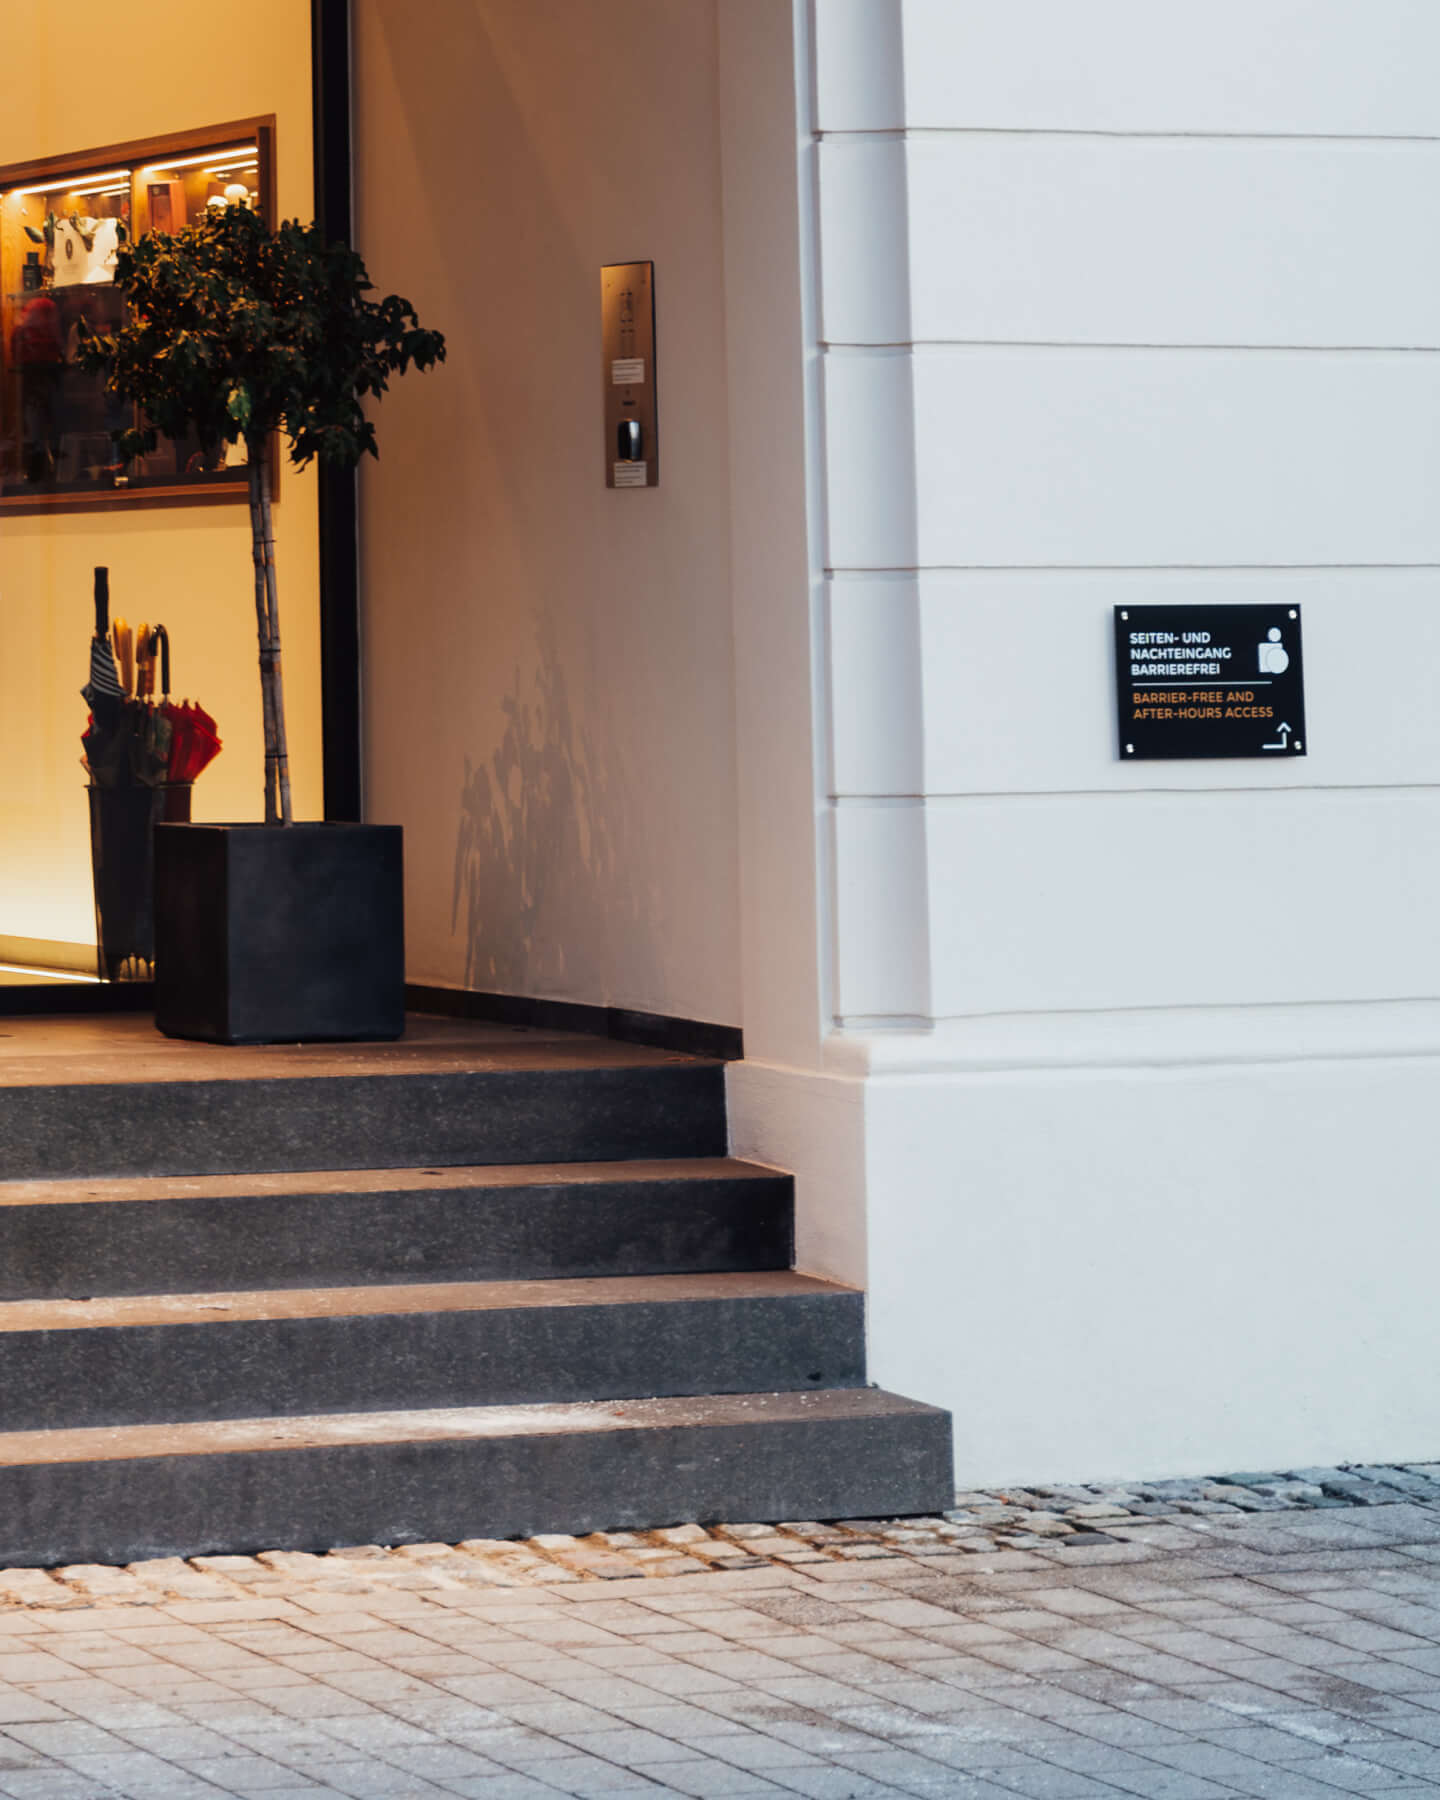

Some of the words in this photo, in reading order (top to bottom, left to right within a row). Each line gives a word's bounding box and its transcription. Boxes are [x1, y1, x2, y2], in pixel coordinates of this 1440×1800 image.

[1129, 632, 1180, 644] SEITEN-
[1182, 631, 1211, 644] UND
[1130, 647, 1232, 660] NACHTEINGANG
[1131, 663, 1220, 676] BARRIEREFREI
[1133, 692, 1224, 705] BARRIER-FREE
[1226, 691, 1255, 703] AND
[1133, 707, 1223, 720] AFTER-HOURS
[1225, 706, 1274, 719] ACCESS
